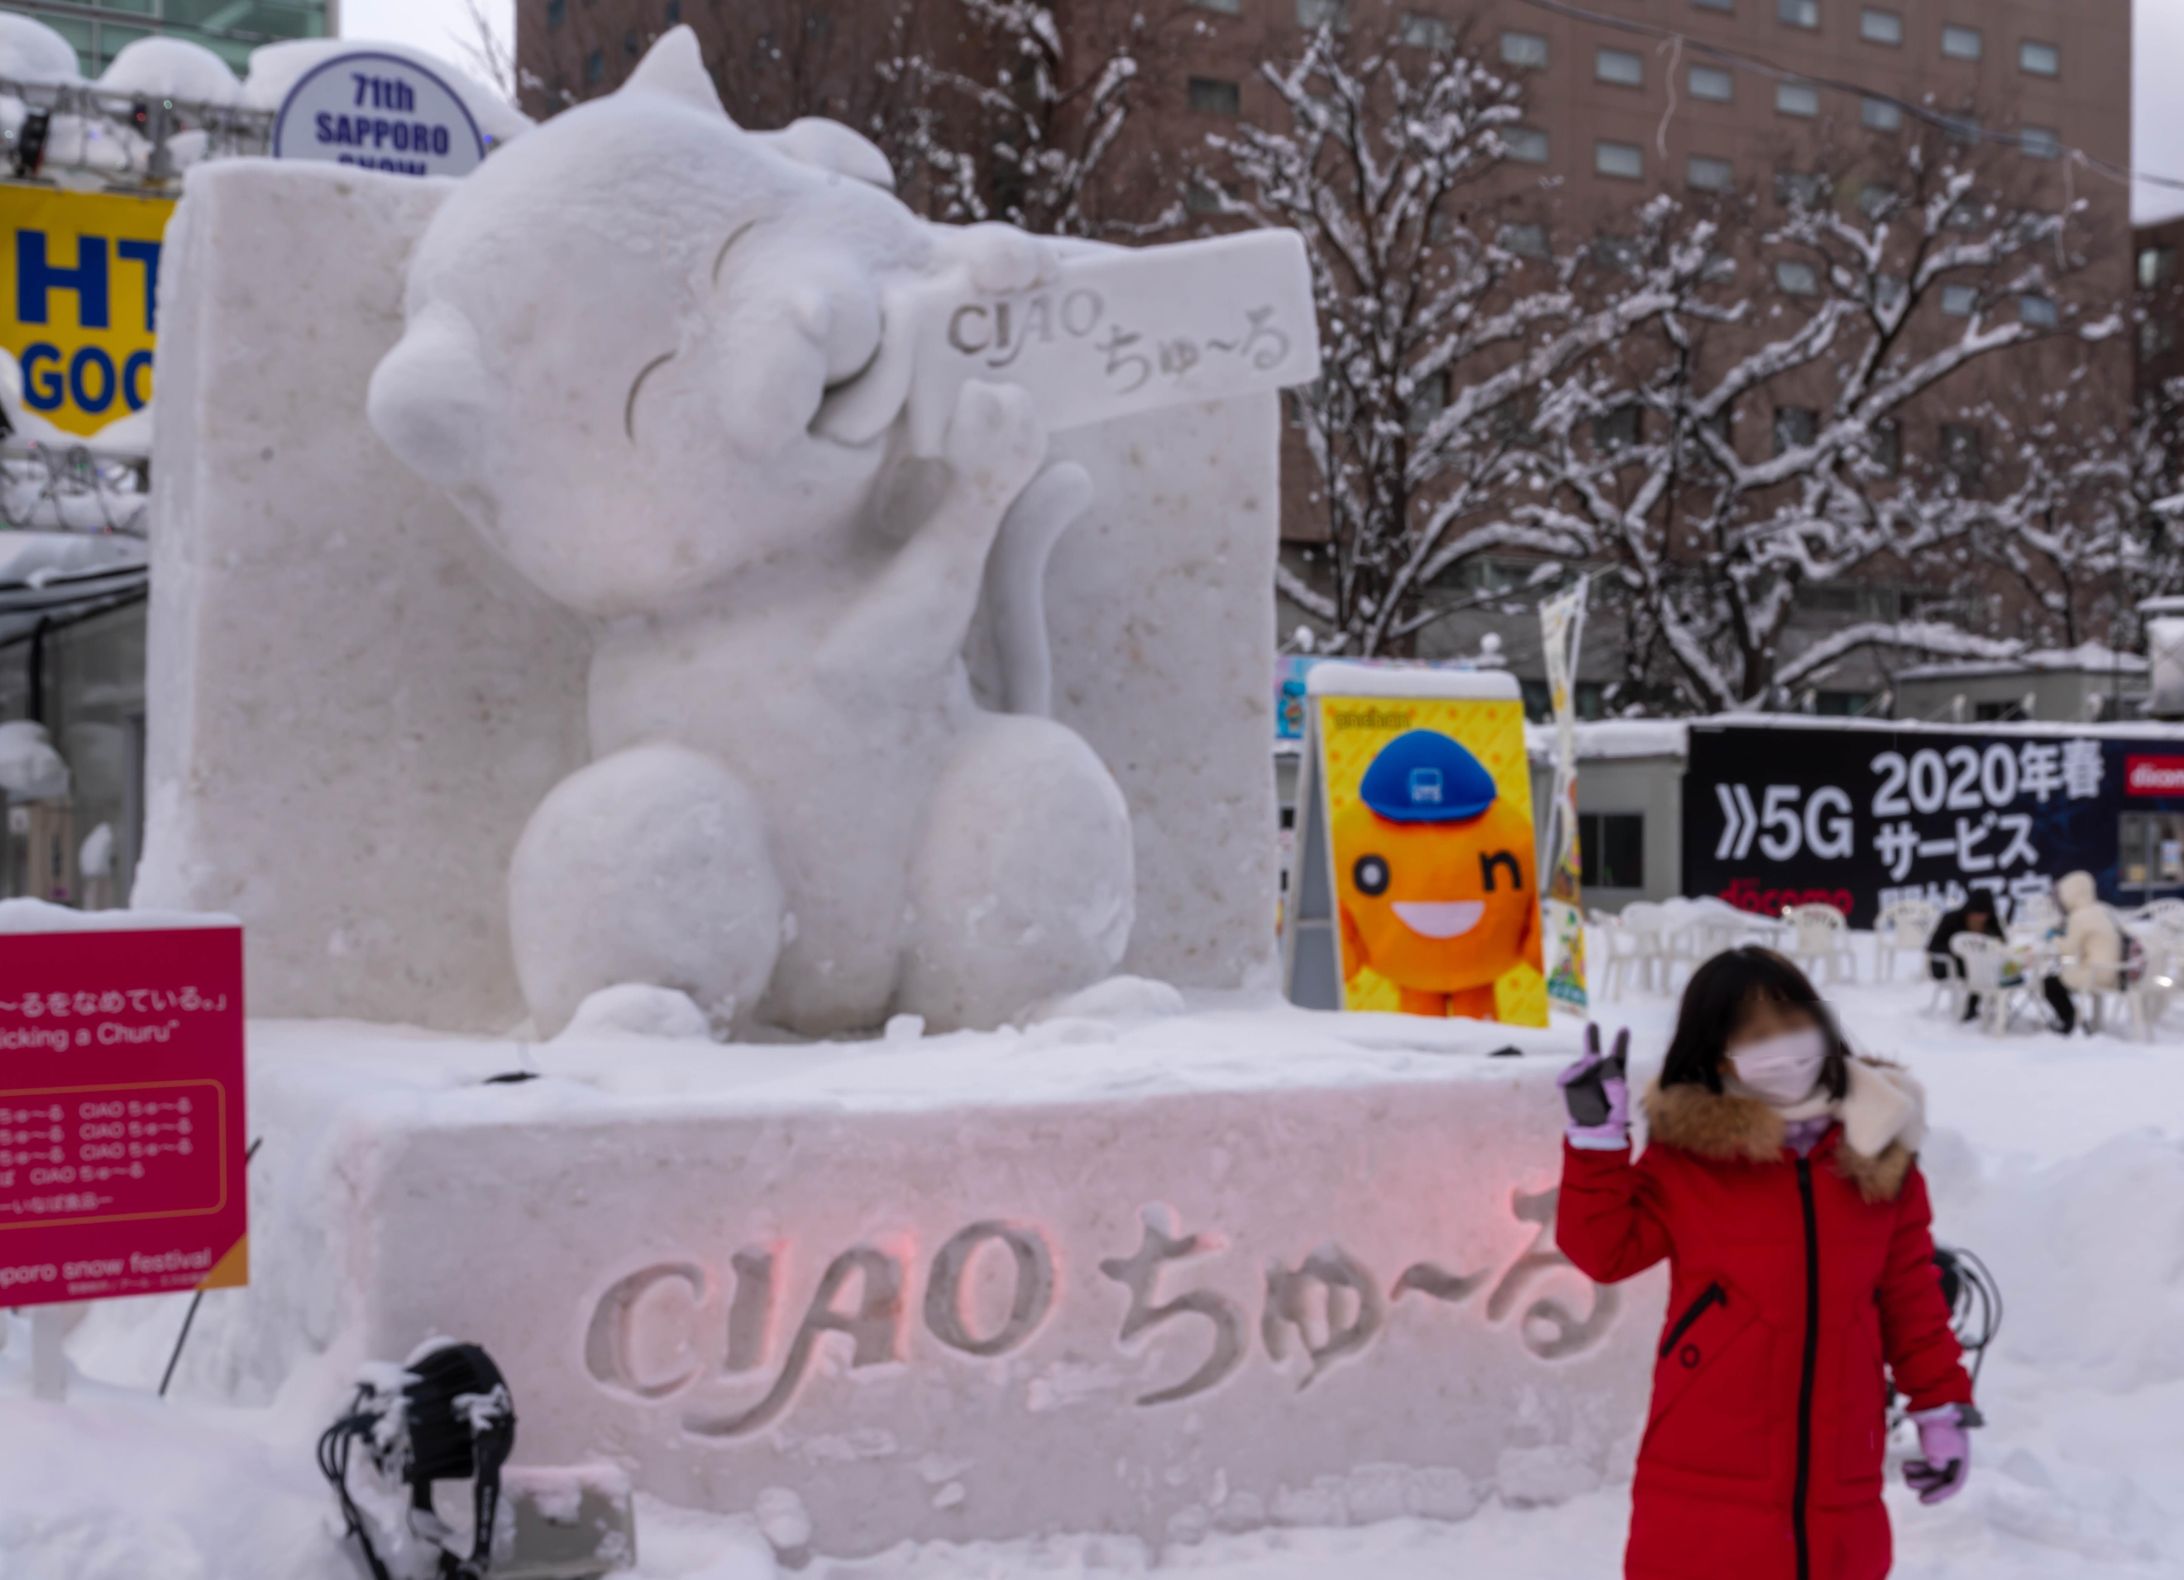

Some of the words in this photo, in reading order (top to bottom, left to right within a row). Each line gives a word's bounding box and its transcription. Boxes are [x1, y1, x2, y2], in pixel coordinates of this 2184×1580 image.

[353, 73, 415, 112] 71th
[315, 112, 450, 157] SAPPORO
[946, 288, 1103, 369] CIAO
[1870, 740, 2105, 818] 2020年春
[1759, 785, 1854, 861] 5G
[1873, 811, 2039, 882] サービス
[75, 1027, 92, 1047] a
[62, 1258, 125, 1280] snow
[129, 1247, 212, 1274] festival
[582, 1218, 1060, 1438] CIAO
